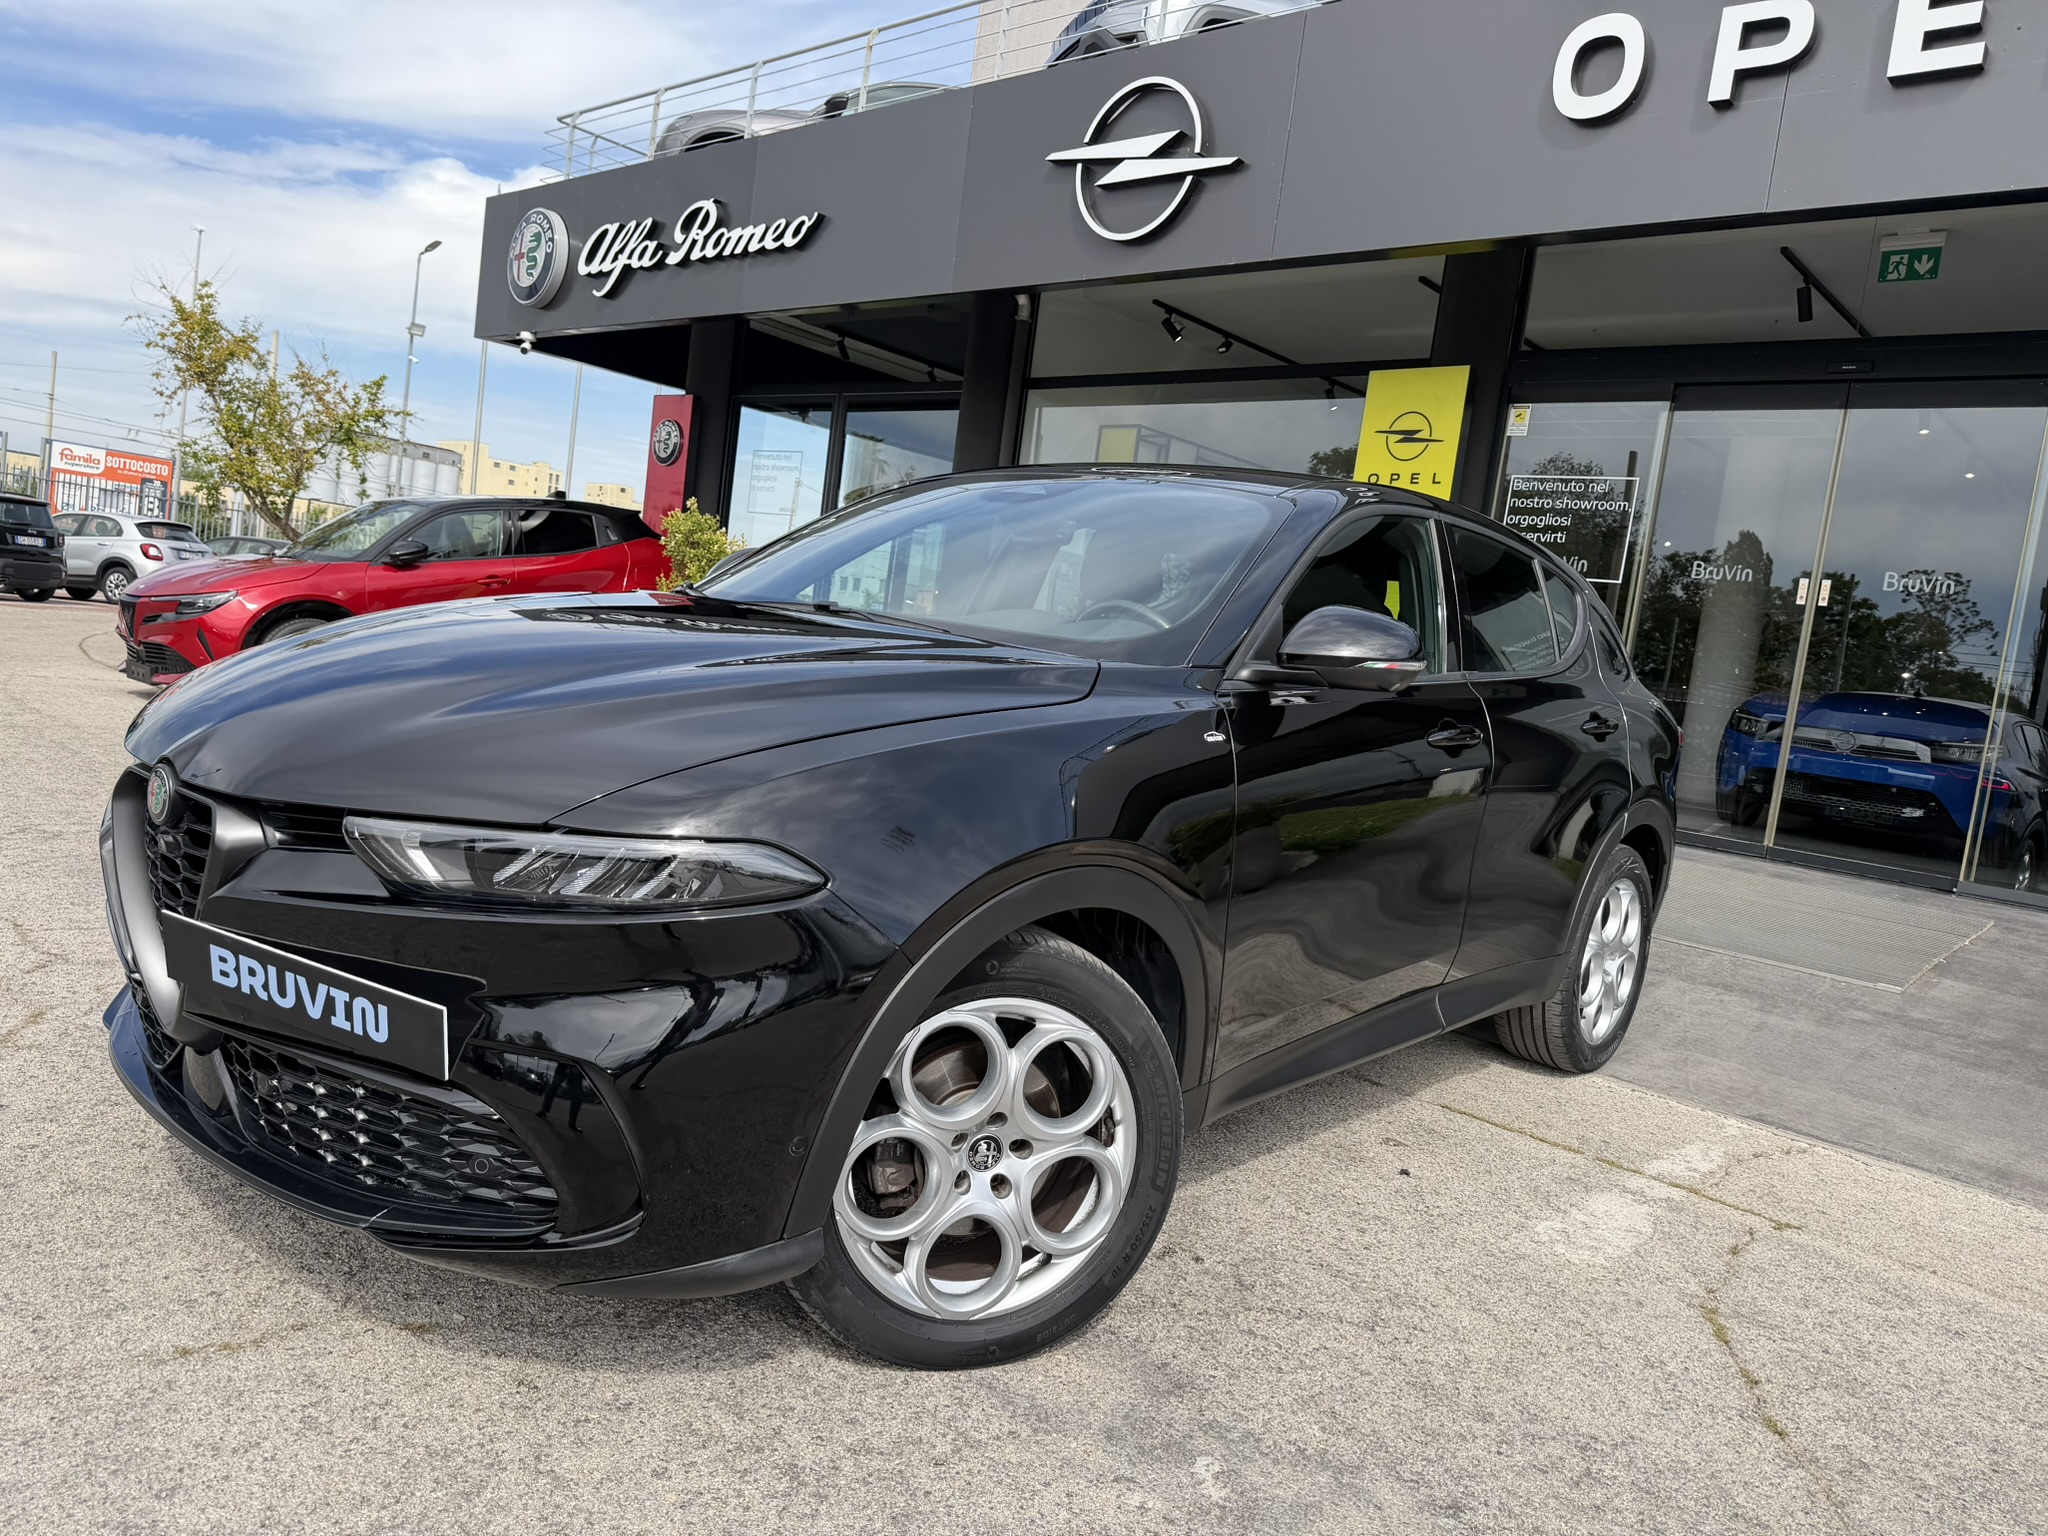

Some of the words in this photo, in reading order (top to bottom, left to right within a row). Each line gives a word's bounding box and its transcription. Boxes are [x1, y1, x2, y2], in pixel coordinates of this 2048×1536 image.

[530, 213, 553, 253] ROMEO
[577, 215, 664, 298] Alfa
[664, 197, 820, 266] Romeo
[59, 447, 101, 465] famila
[64, 461, 100, 471] superstore
[105, 455, 169, 476] SOTTOCOSTO
[1367, 472, 1441, 485] OPEL
[1512, 479, 1585, 492] Benvenuto
[1588, 480, 1610, 493] nel
[1510, 497, 1552, 509] nostro
[1555, 497, 1632, 513] showroom,
[1507, 513, 1572, 528] orgogliosi
[1691, 560, 1753, 582] BruVin
[1882, 571, 1956, 595] BruVin
[209, 943, 389, 1044] BRUVIN
[1153, 1074, 1172, 1188] MICHELIN
[968, 1151, 985, 1170] ROMEO
[1036, 1313, 1077, 1343] OUTSIDE
